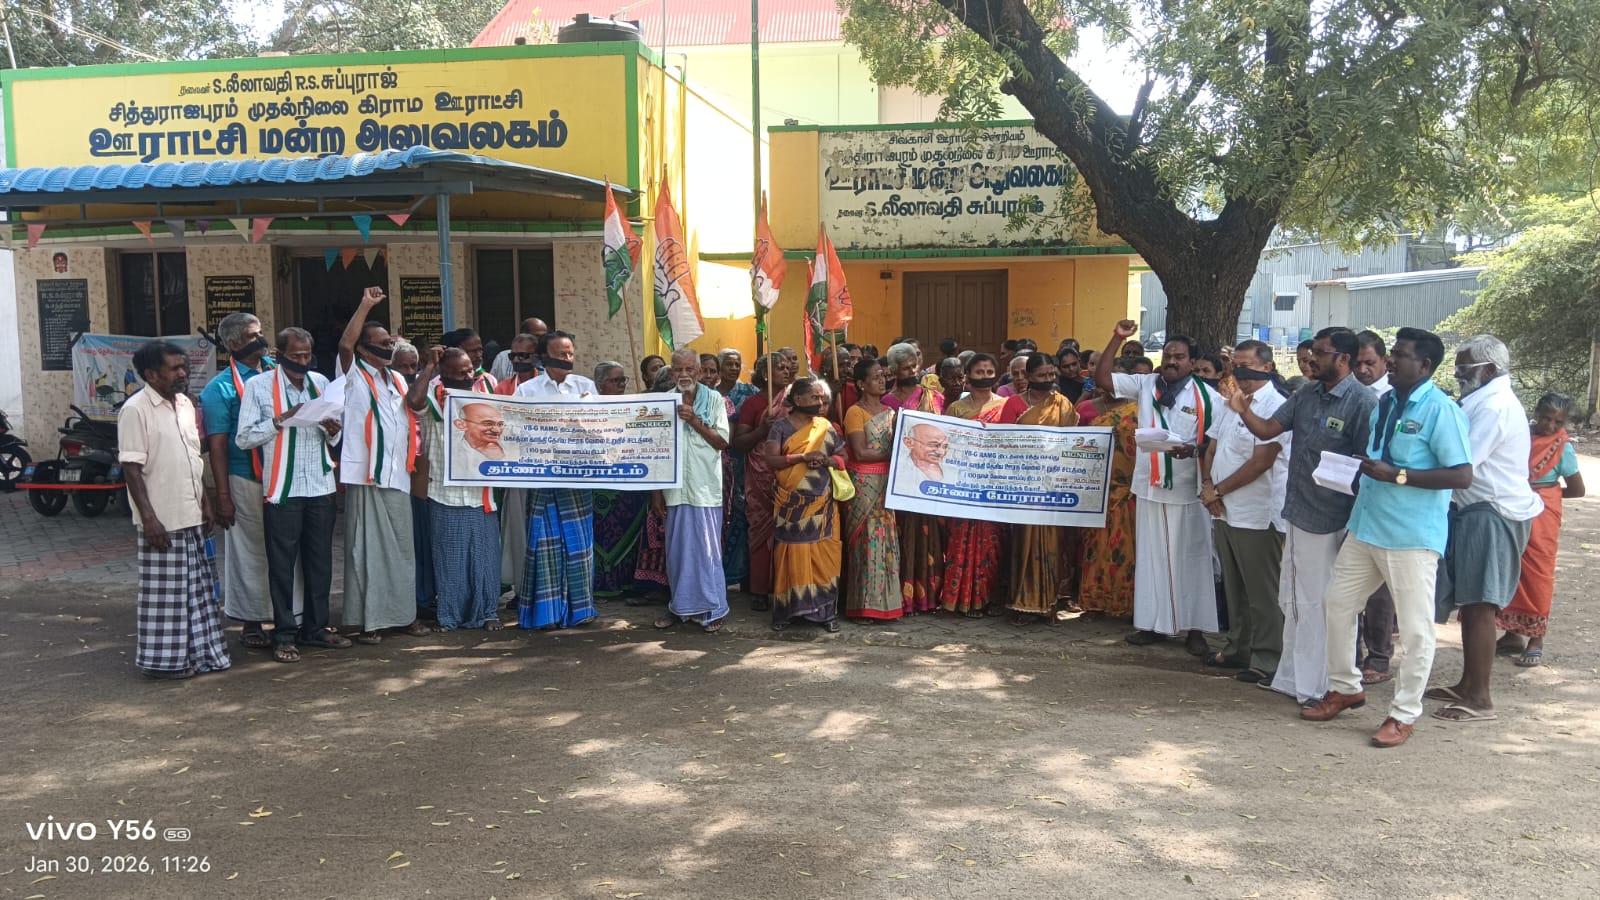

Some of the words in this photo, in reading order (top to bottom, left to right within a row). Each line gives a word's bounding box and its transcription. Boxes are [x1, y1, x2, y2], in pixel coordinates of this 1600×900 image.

[213, 70, 292, 95] S.லீலாவதி
[109, 97, 238, 128] சித்துராஜபுரம்
[248, 96, 349, 122] முதல்நிலை
[358, 94, 423, 118] கிராம
[434, 89, 523, 116] ஊராட்சி
[89, 122, 247, 163] ஊராட்சி
[259, 120, 346, 158] மன்ற
[356, 109, 568, 152] அலுவலகம்
[888, 133, 932, 144] சிவகாசி
[488, 464, 547, 475] தர்ணா
[552, 465, 644, 476] போராட்டம்
[926, 484, 982, 499] தர்ணா
[986, 490, 1074, 504] போராட்டம்
